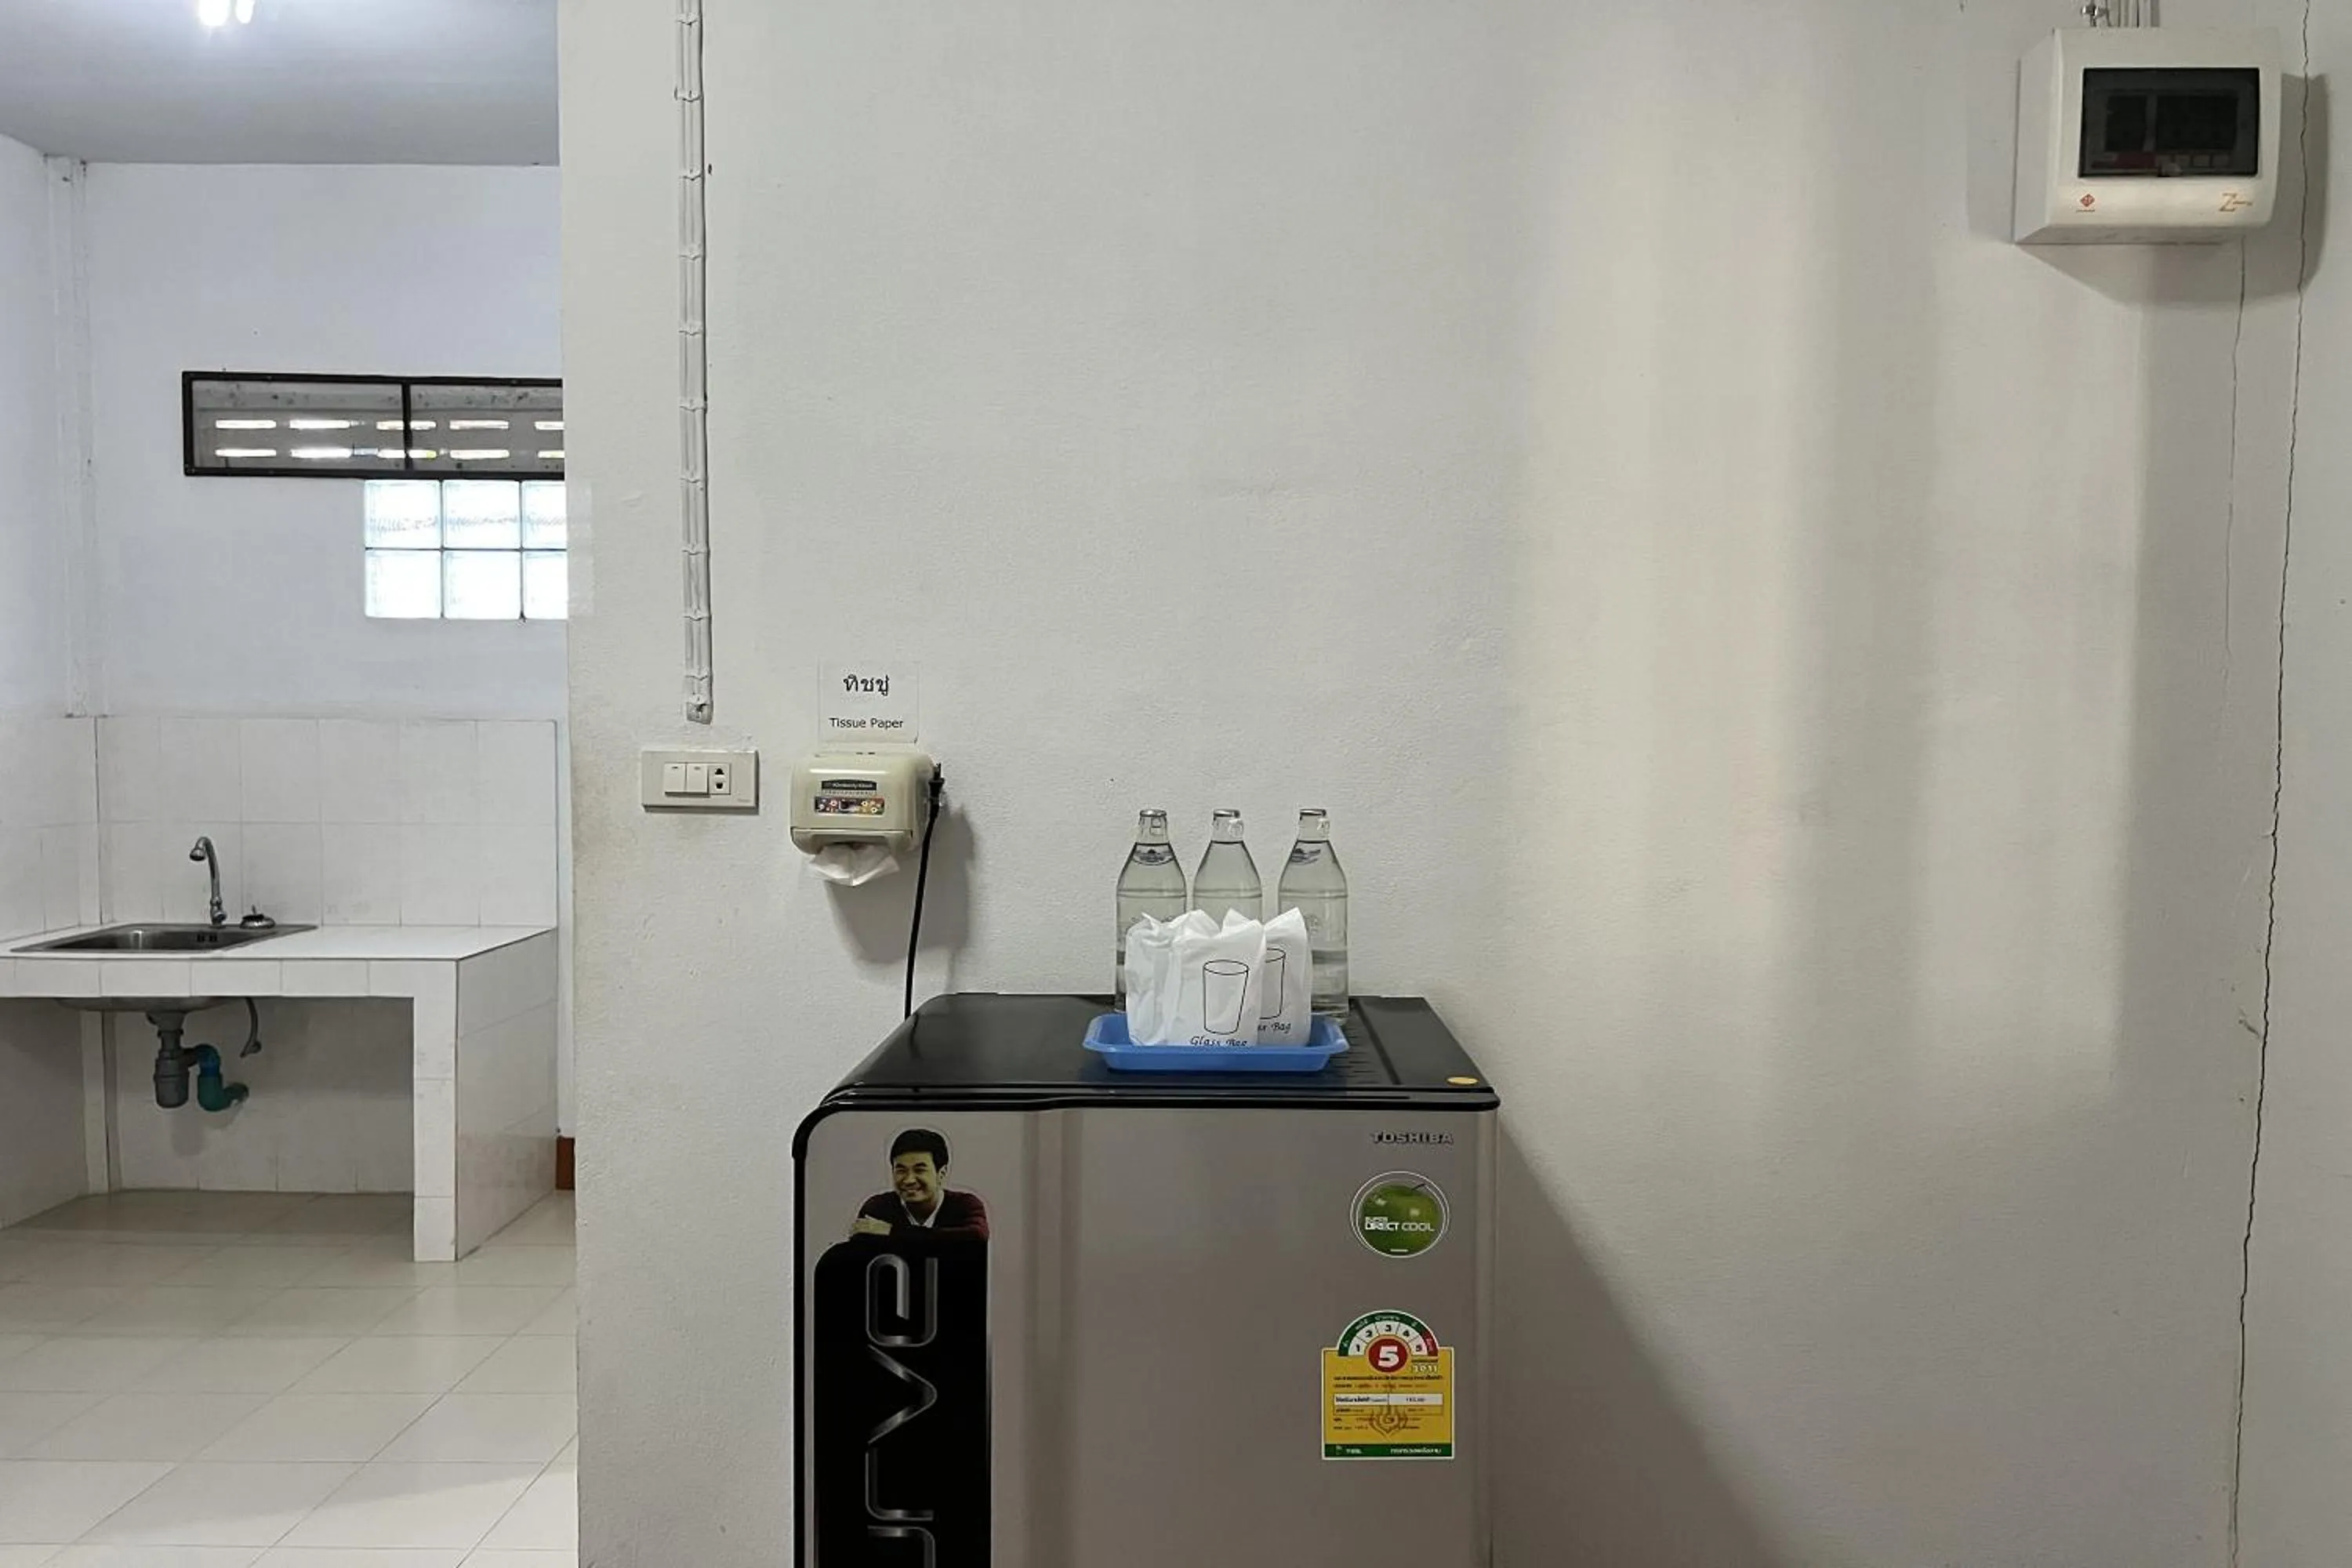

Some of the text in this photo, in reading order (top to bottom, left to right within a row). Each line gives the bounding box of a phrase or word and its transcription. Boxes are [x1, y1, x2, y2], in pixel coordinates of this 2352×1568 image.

[843, 673, 890, 696] ทิชชู่
[829, 717, 904, 731] Tissue Paper
[1189, 1035, 1221, 1047] Glass
[1372, 1131, 1454, 1144] TOSHIBA
[1401, 1221, 1436, 1232] COOL
[1377, 1345, 1400, 1368] 5
